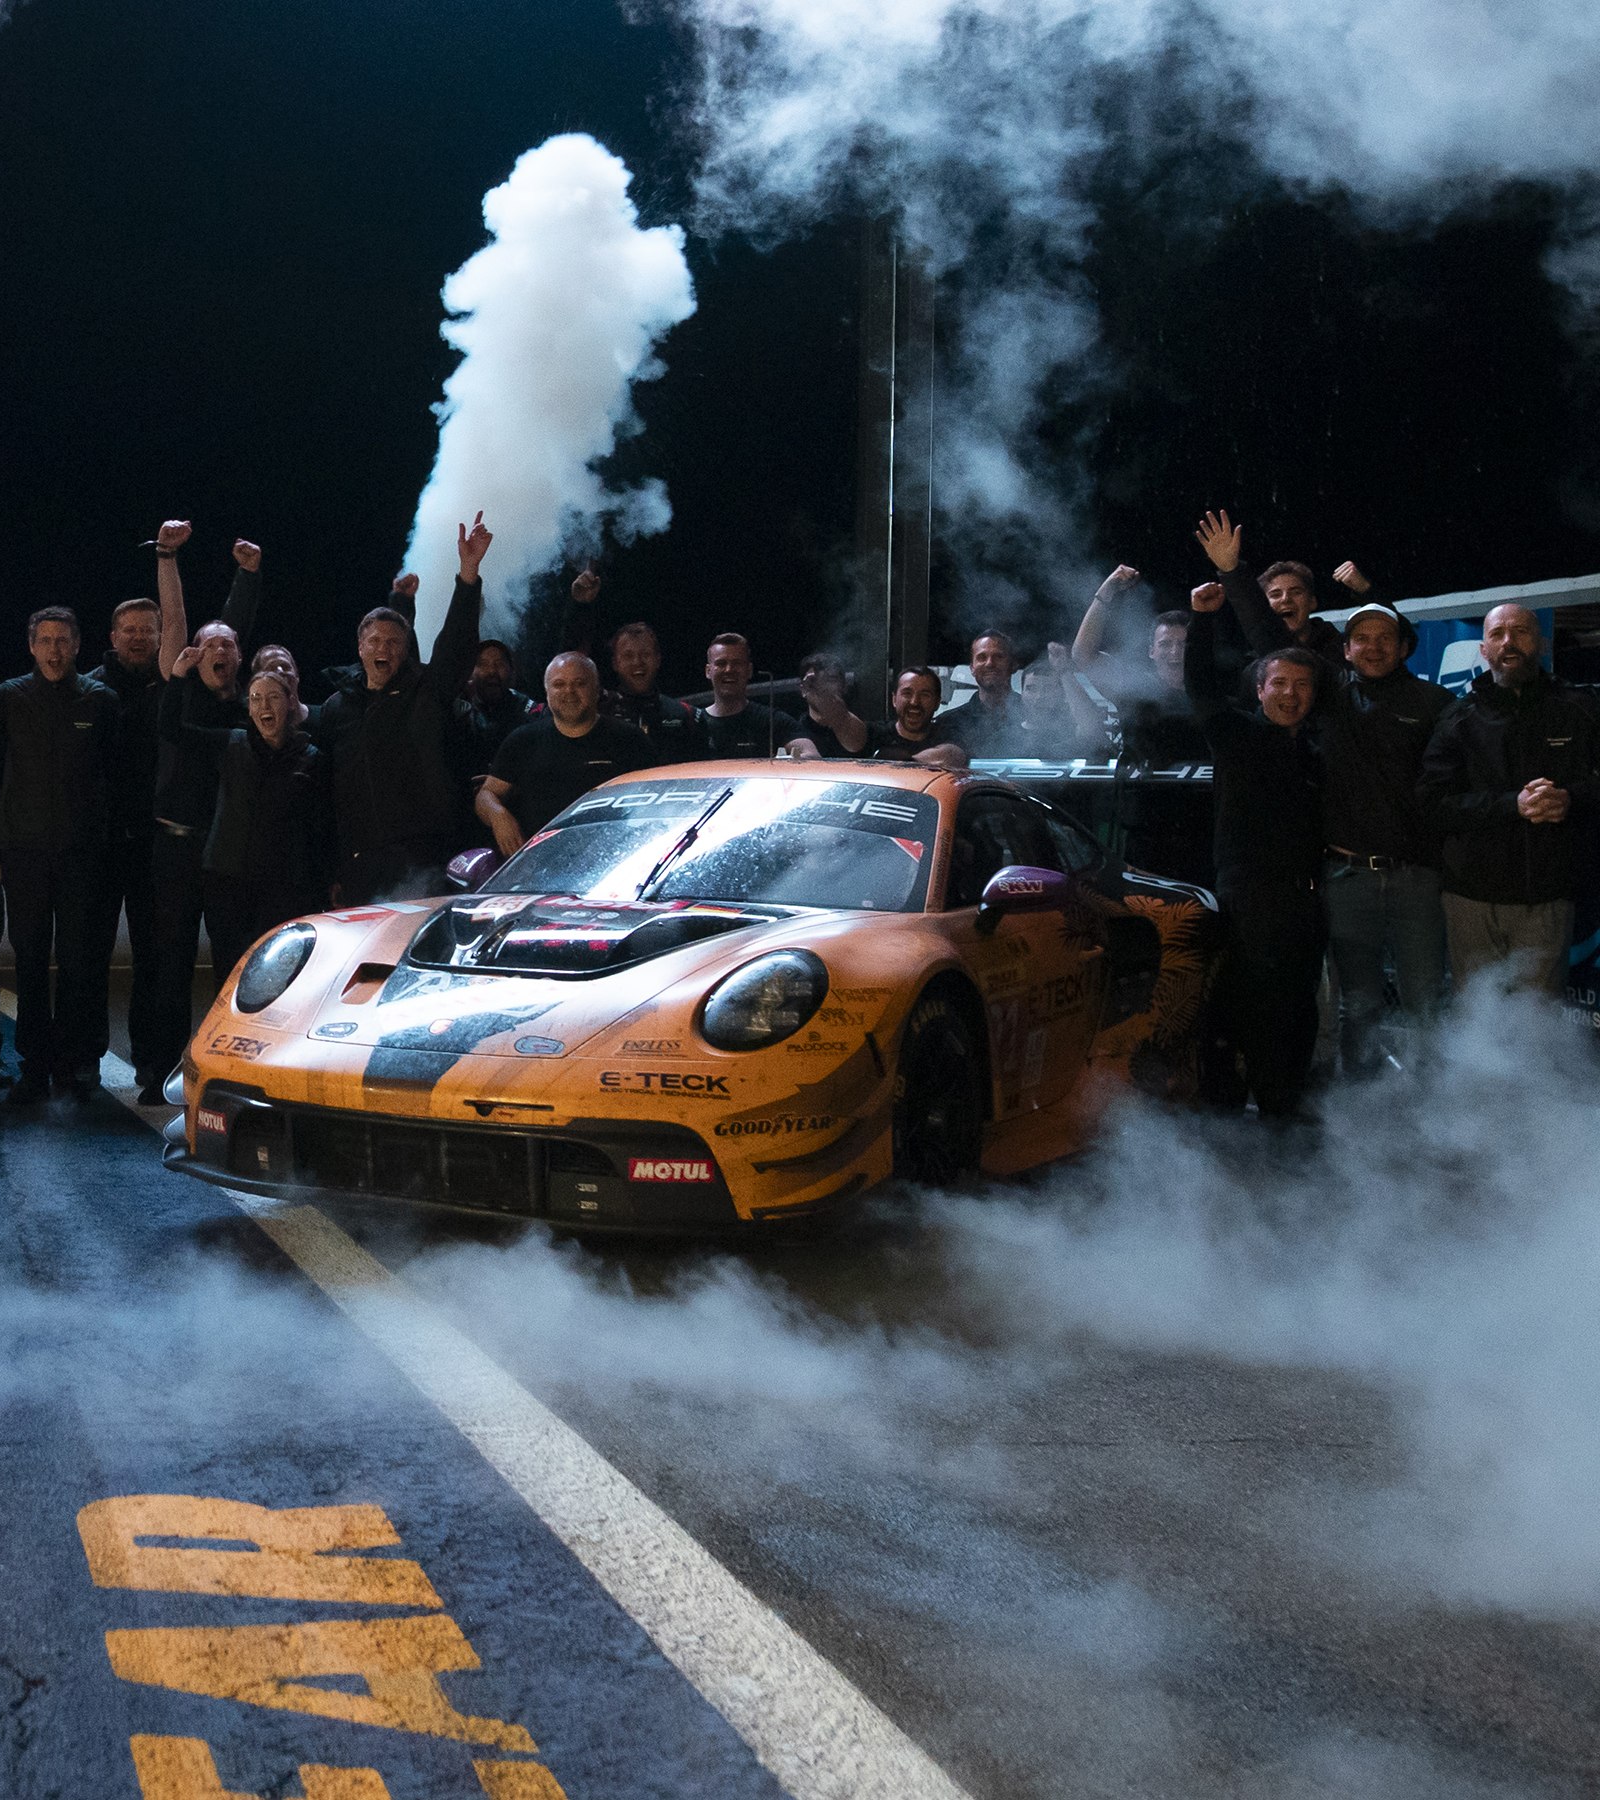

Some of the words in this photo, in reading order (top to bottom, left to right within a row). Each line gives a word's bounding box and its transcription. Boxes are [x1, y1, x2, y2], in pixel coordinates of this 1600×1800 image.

[1008, 879, 1043, 894] KW
[621, 1039, 682, 1052] ENDLESS
[714, 1112, 832, 1137] GOODYEAR
[633, 1162, 711, 1180] MOTUL
